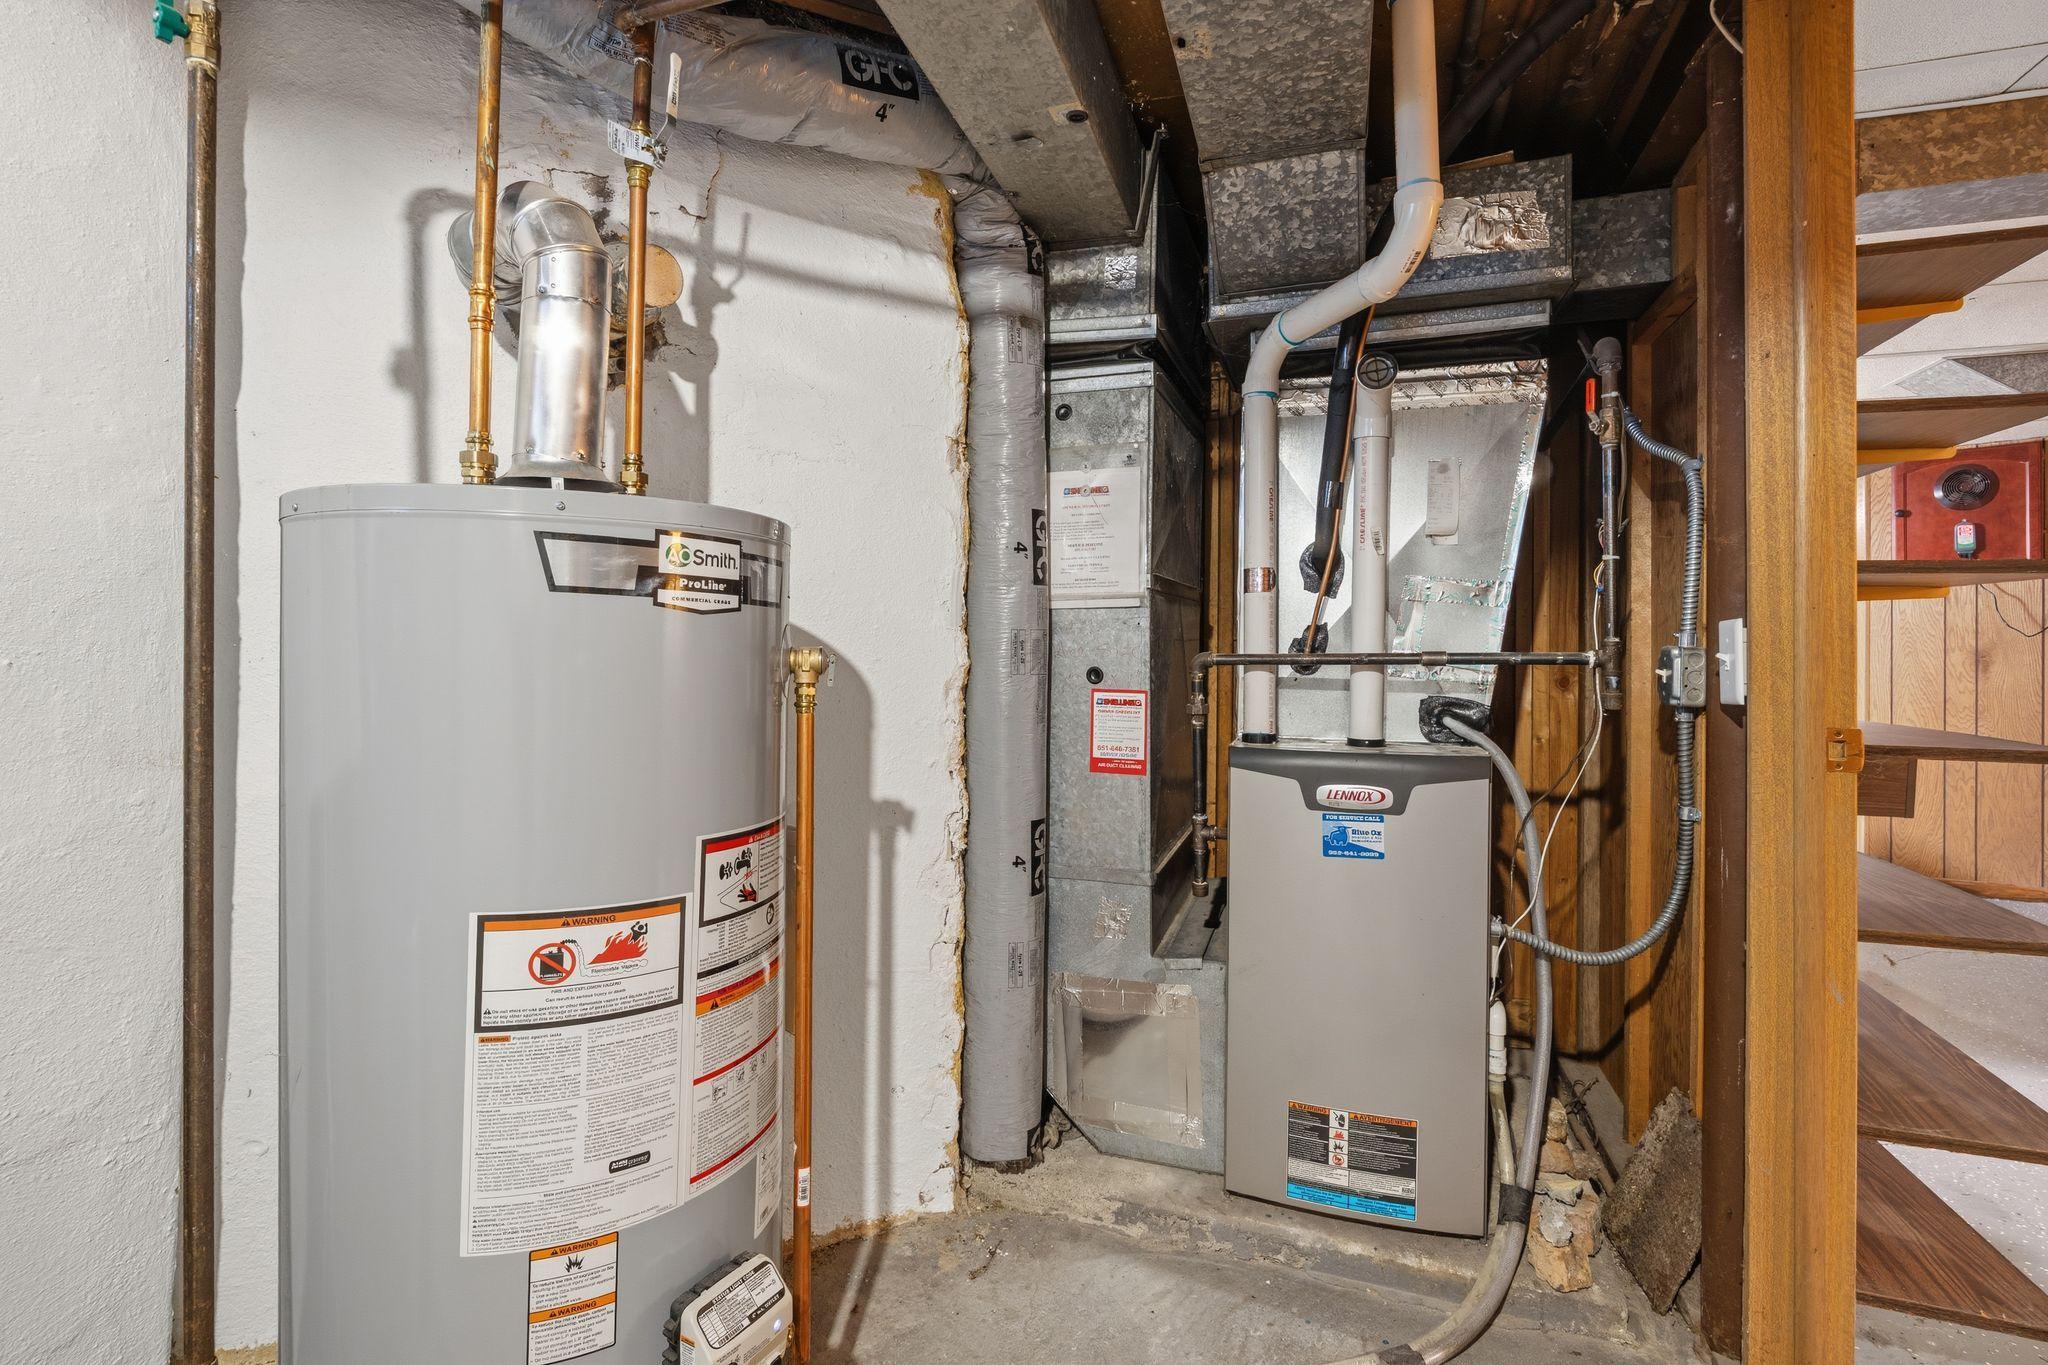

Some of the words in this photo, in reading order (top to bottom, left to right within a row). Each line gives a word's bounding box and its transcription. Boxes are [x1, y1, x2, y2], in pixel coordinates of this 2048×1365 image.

[844, 49, 913, 91] GFC
[875, 103, 895, 123] 4"
[1014, 542, 1029, 559] 4"
[692, 550, 736, 570] Smith
[680, 578, 726, 591] ProLine
[671, 596, 712, 605] COMMERCIAL
[1326, 789, 1374, 802] LENNOX
[1012, 855, 1027, 872] 4"
[572, 914, 616, 926] WARNING
[1297, 1103, 1327, 1114] WARNING
[559, 1239, 599, 1254] WARNING
[558, 1301, 597, 1316] WARNING
